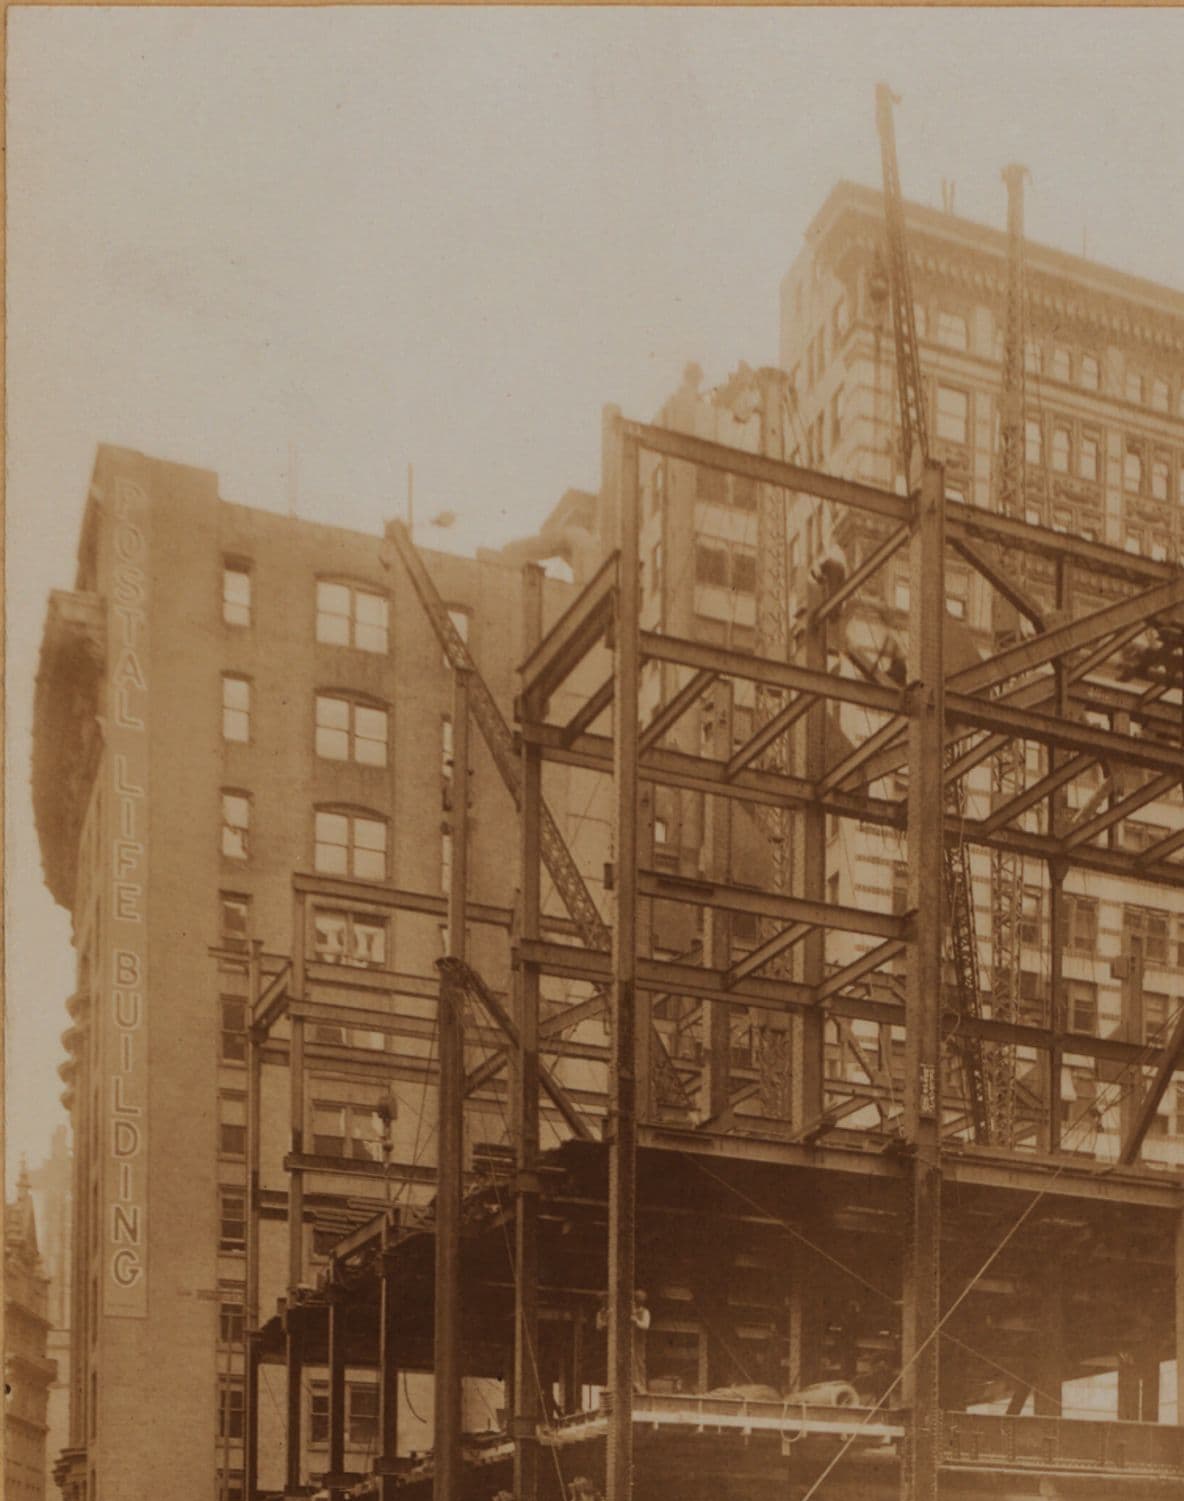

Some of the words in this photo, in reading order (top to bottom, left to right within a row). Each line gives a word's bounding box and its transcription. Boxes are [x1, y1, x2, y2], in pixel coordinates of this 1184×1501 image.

[113, 476, 147, 731] POSTAL
[112, 754, 145, 923] LIFE
[112, 951, 143, 1289] BUILDING
